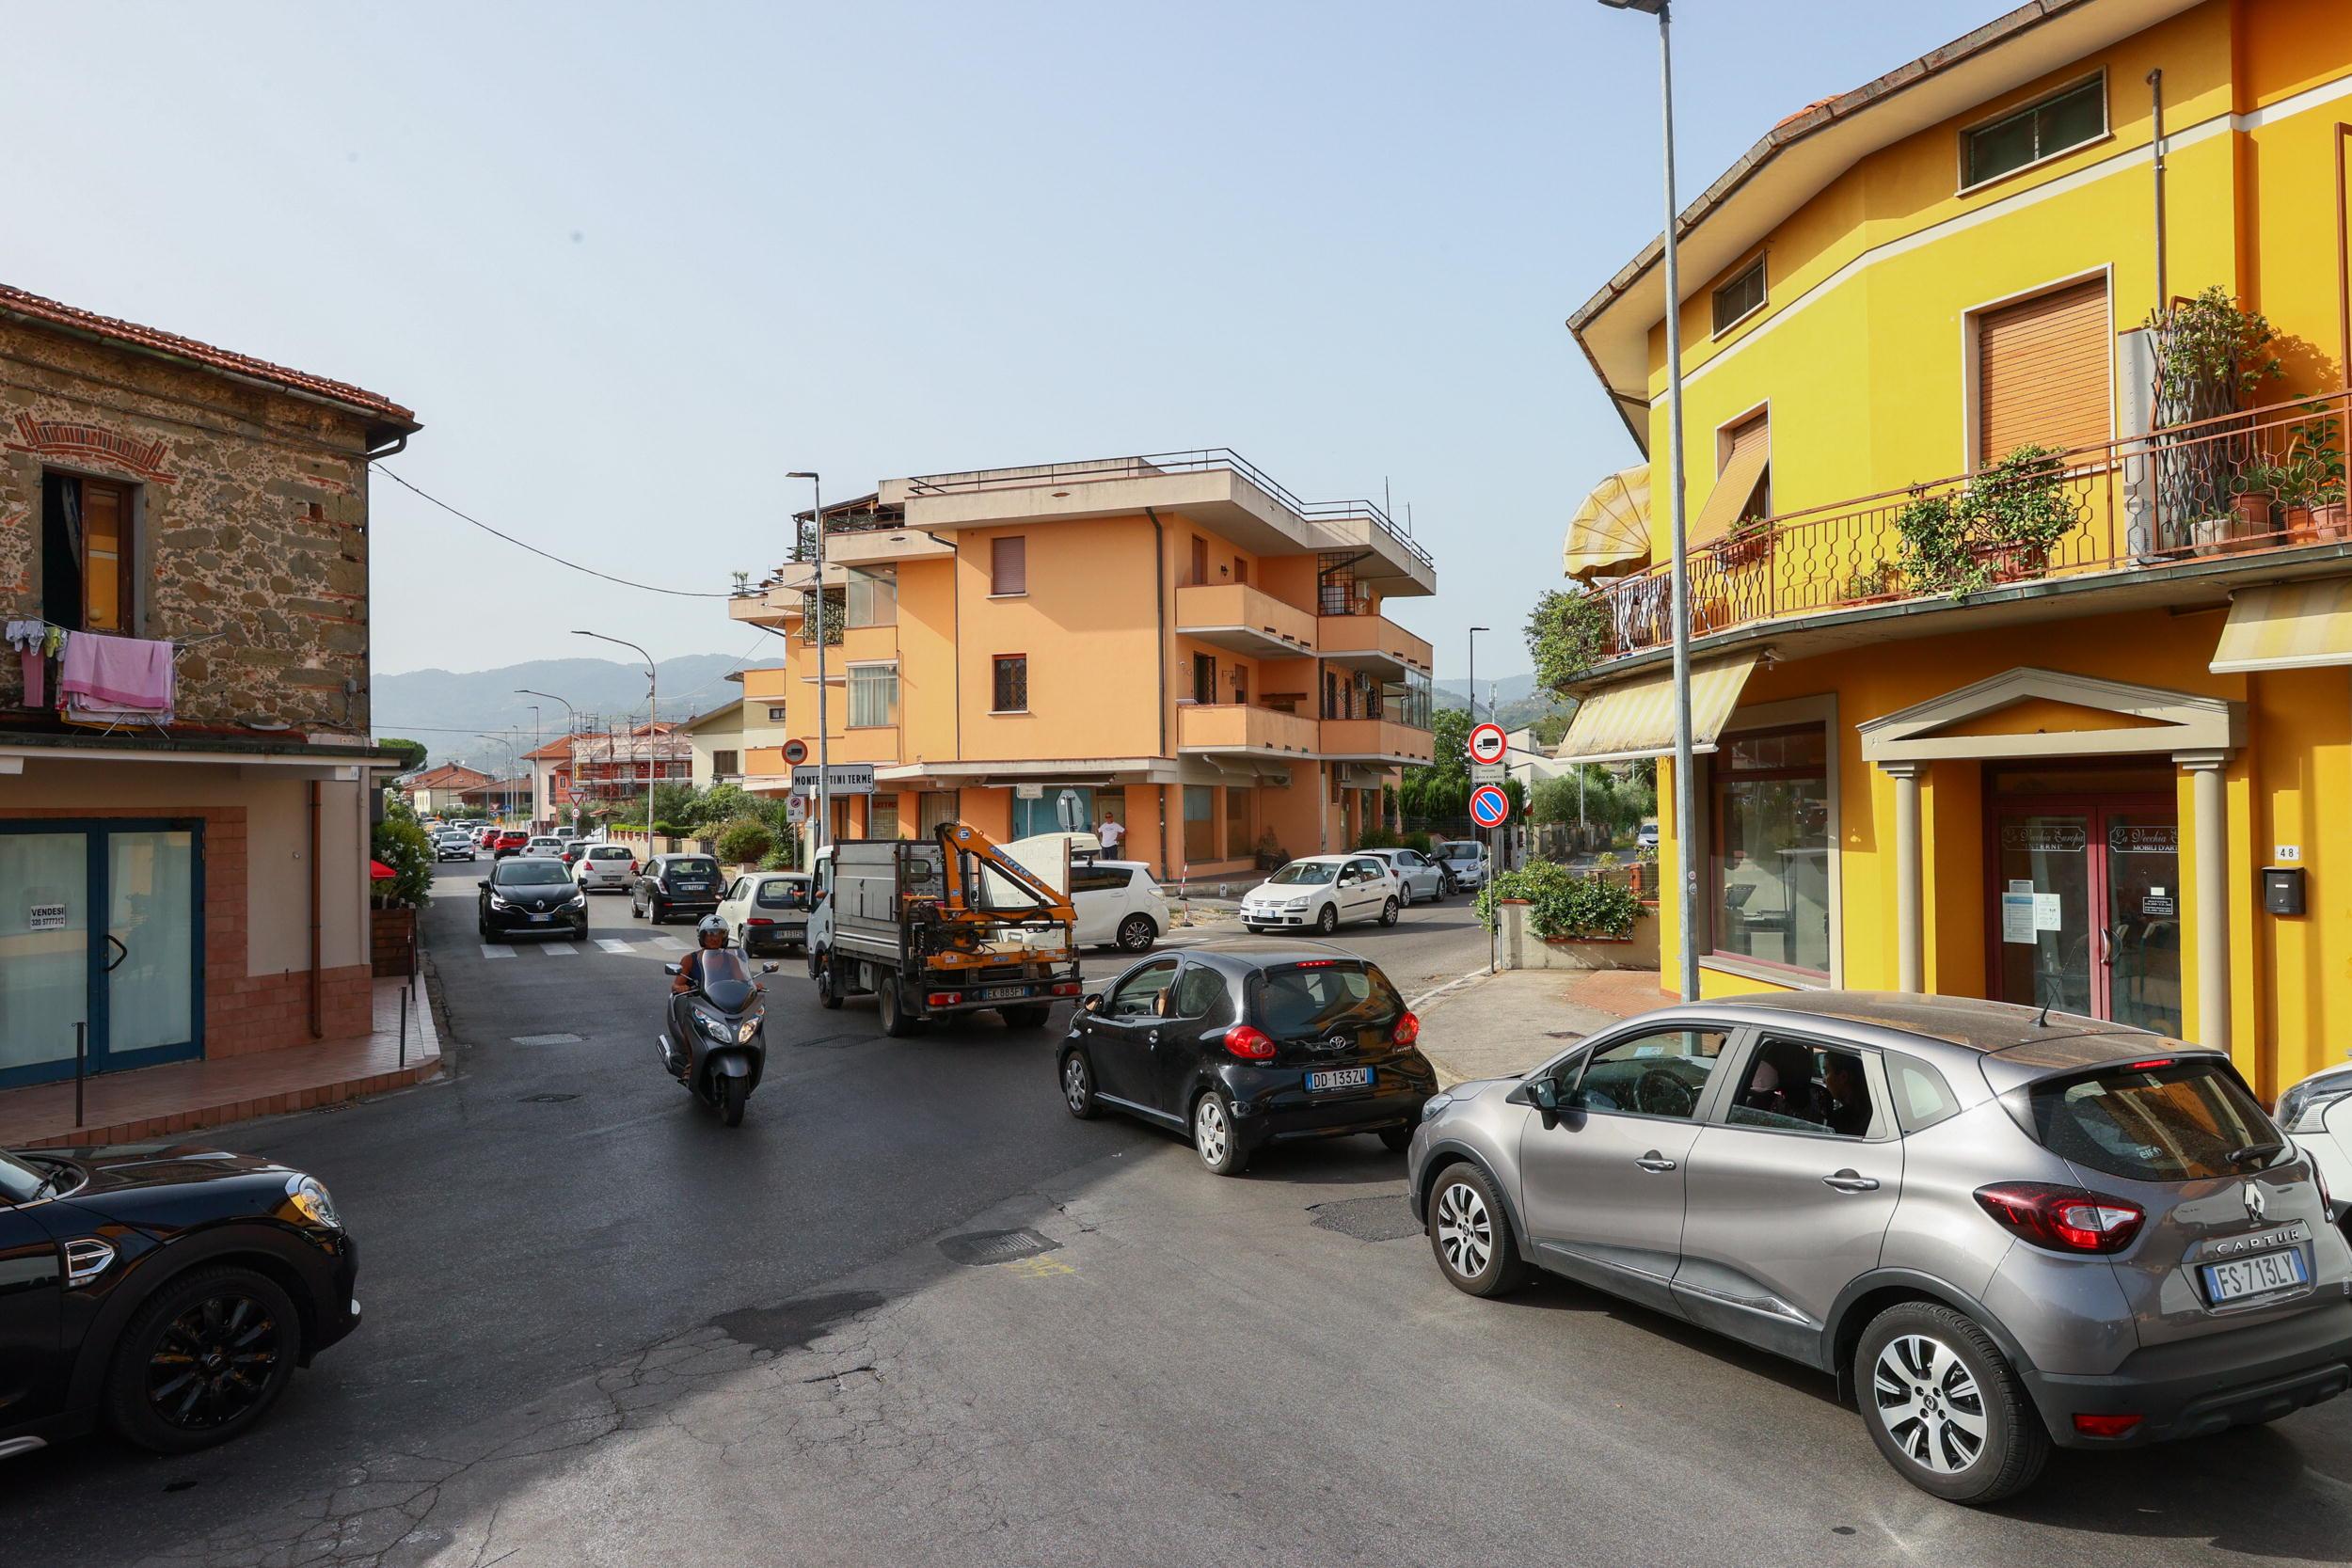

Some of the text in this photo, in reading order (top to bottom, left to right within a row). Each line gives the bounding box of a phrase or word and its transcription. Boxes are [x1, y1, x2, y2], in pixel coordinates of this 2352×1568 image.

[795, 774, 872, 785] MONTETINI TERME
[2111, 828, 2128, 845] La
[2131, 828, 2167, 843] Vecchia
[2280, 847, 2295, 858] 48
[31, 907, 64, 917] VENDESI
[2216, 1229, 2299, 1255] CAPTUR
